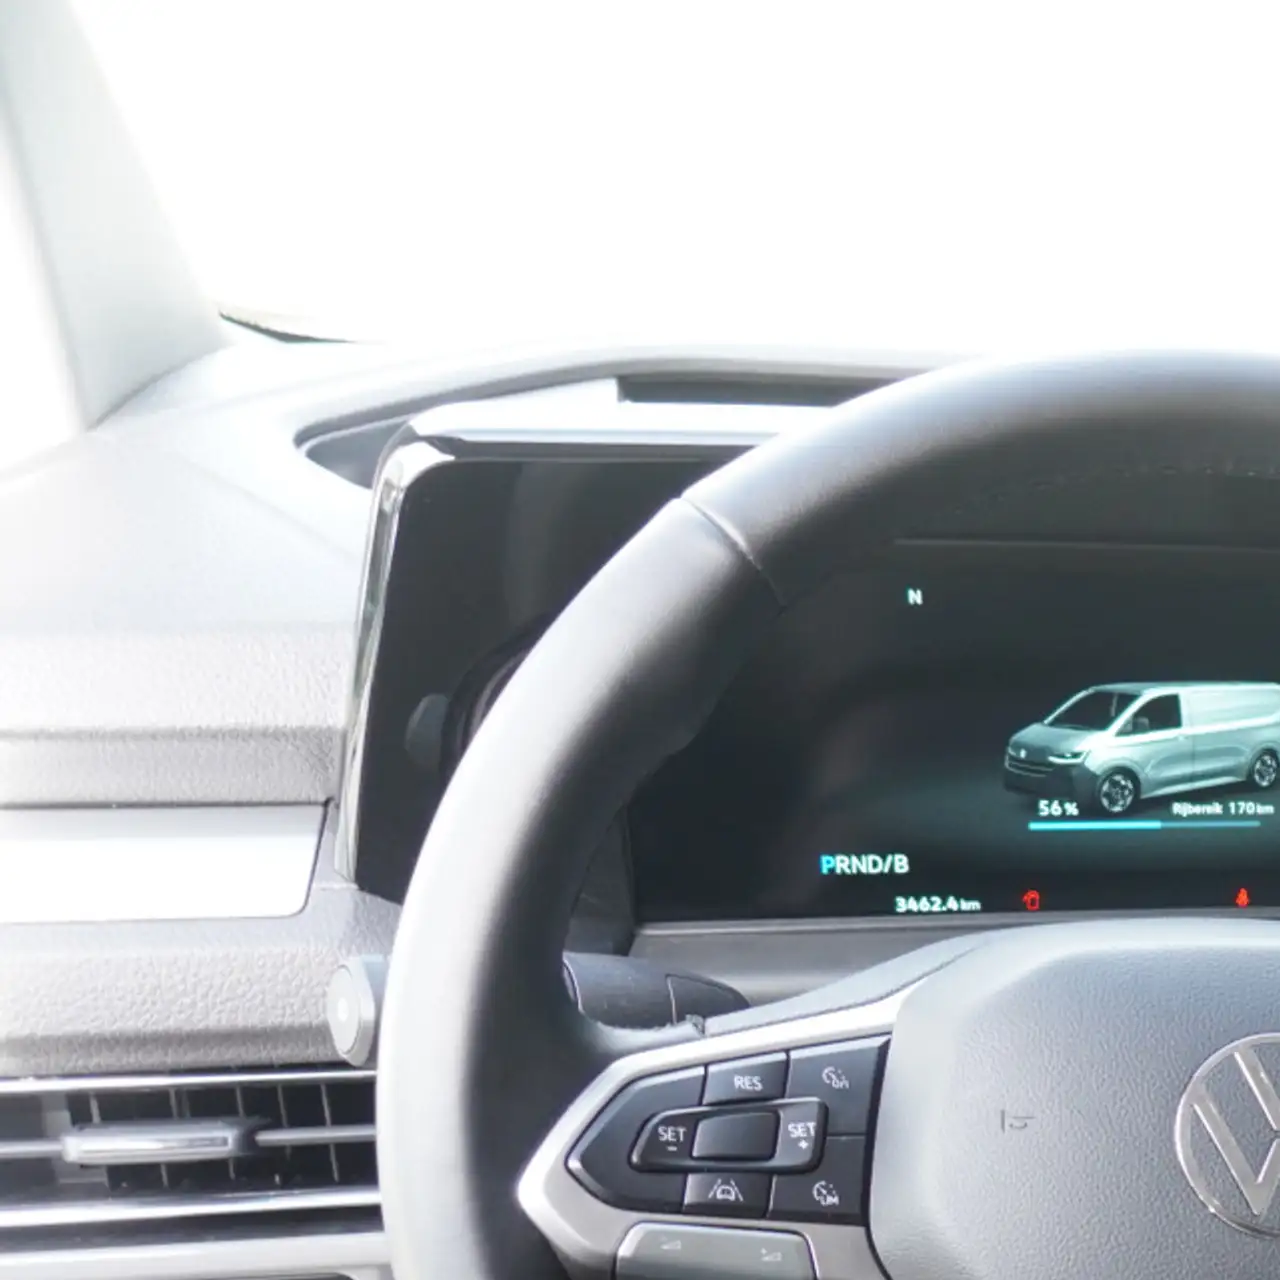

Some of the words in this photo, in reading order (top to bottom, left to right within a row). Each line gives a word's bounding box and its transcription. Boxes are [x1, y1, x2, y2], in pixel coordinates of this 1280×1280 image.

[908, 588, 923, 605] N
[1038, 800, 1063, 817] 56
[1064, 802, 1079, 816] %
[1229, 801, 1256, 816] 170
[820, 854, 909, 874] PRND/B
[895, 896, 958, 912] 3462.4
[960, 899, 981, 912] km
[734, 1075, 763, 1091] RES
[658, 1126, 686, 1142] SET
[788, 1122, 817, 1138] SET
